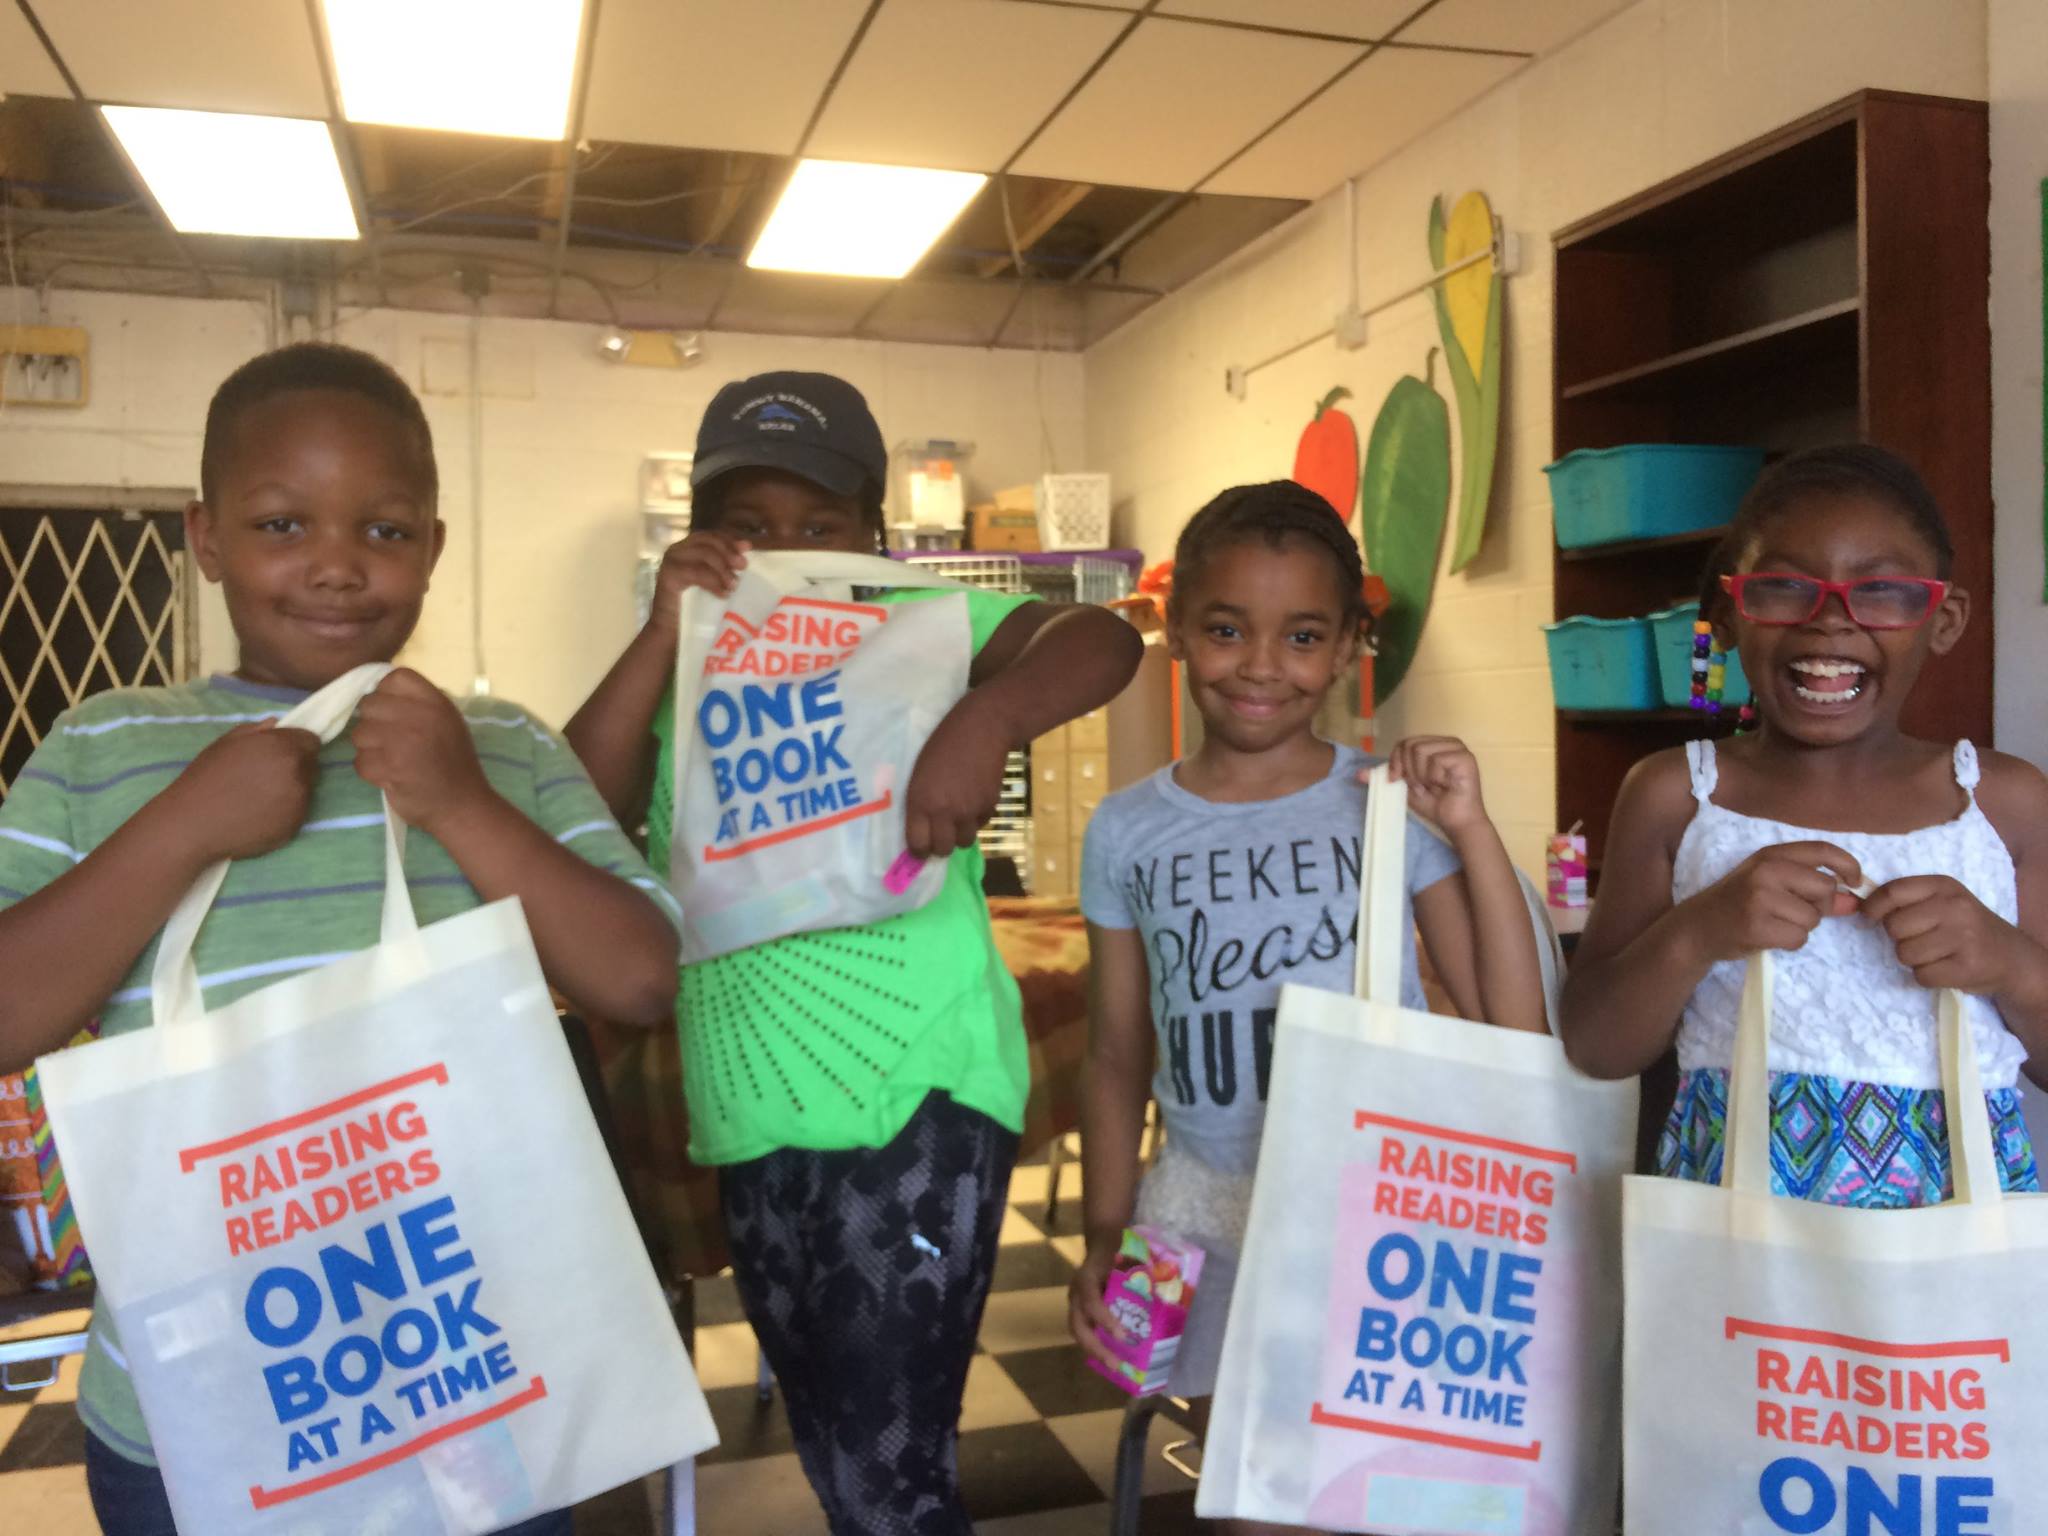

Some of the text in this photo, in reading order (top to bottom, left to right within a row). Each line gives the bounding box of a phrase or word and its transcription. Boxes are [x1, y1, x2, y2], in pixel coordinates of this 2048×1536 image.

[713, 612, 862, 656] RSING
[698, 669, 843, 749] ONE
[711, 724, 851, 804] BOOK
[750, 802, 772, 832] A
[777, 777, 861, 822] TIME
[1127, 836, 1361, 913] WEEKEN
[1152, 907, 1356, 1028] Pleas
[220, 1102, 426, 1207] RAISING
[1379, 1138, 1553, 1206] RAISING
[226, 1149, 439, 1256] READERS
[1374, 1182, 1547, 1245] READERS
[245, 1196, 475, 1349] ONE
[1367, 1233, 1542, 1324] ONE
[262, 1279, 500, 1425] BOOK
[1355, 1307, 1532, 1386] BOOK
[1757, 1349, 1985, 1411] RAISING
[287, 1342, 517, 1472] AT A TIME
[1344, 1370, 1525, 1427] AT A TIME
[1757, 1400, 1989, 1460] READERS
[1758, 1456, 1994, 1536] ONE
